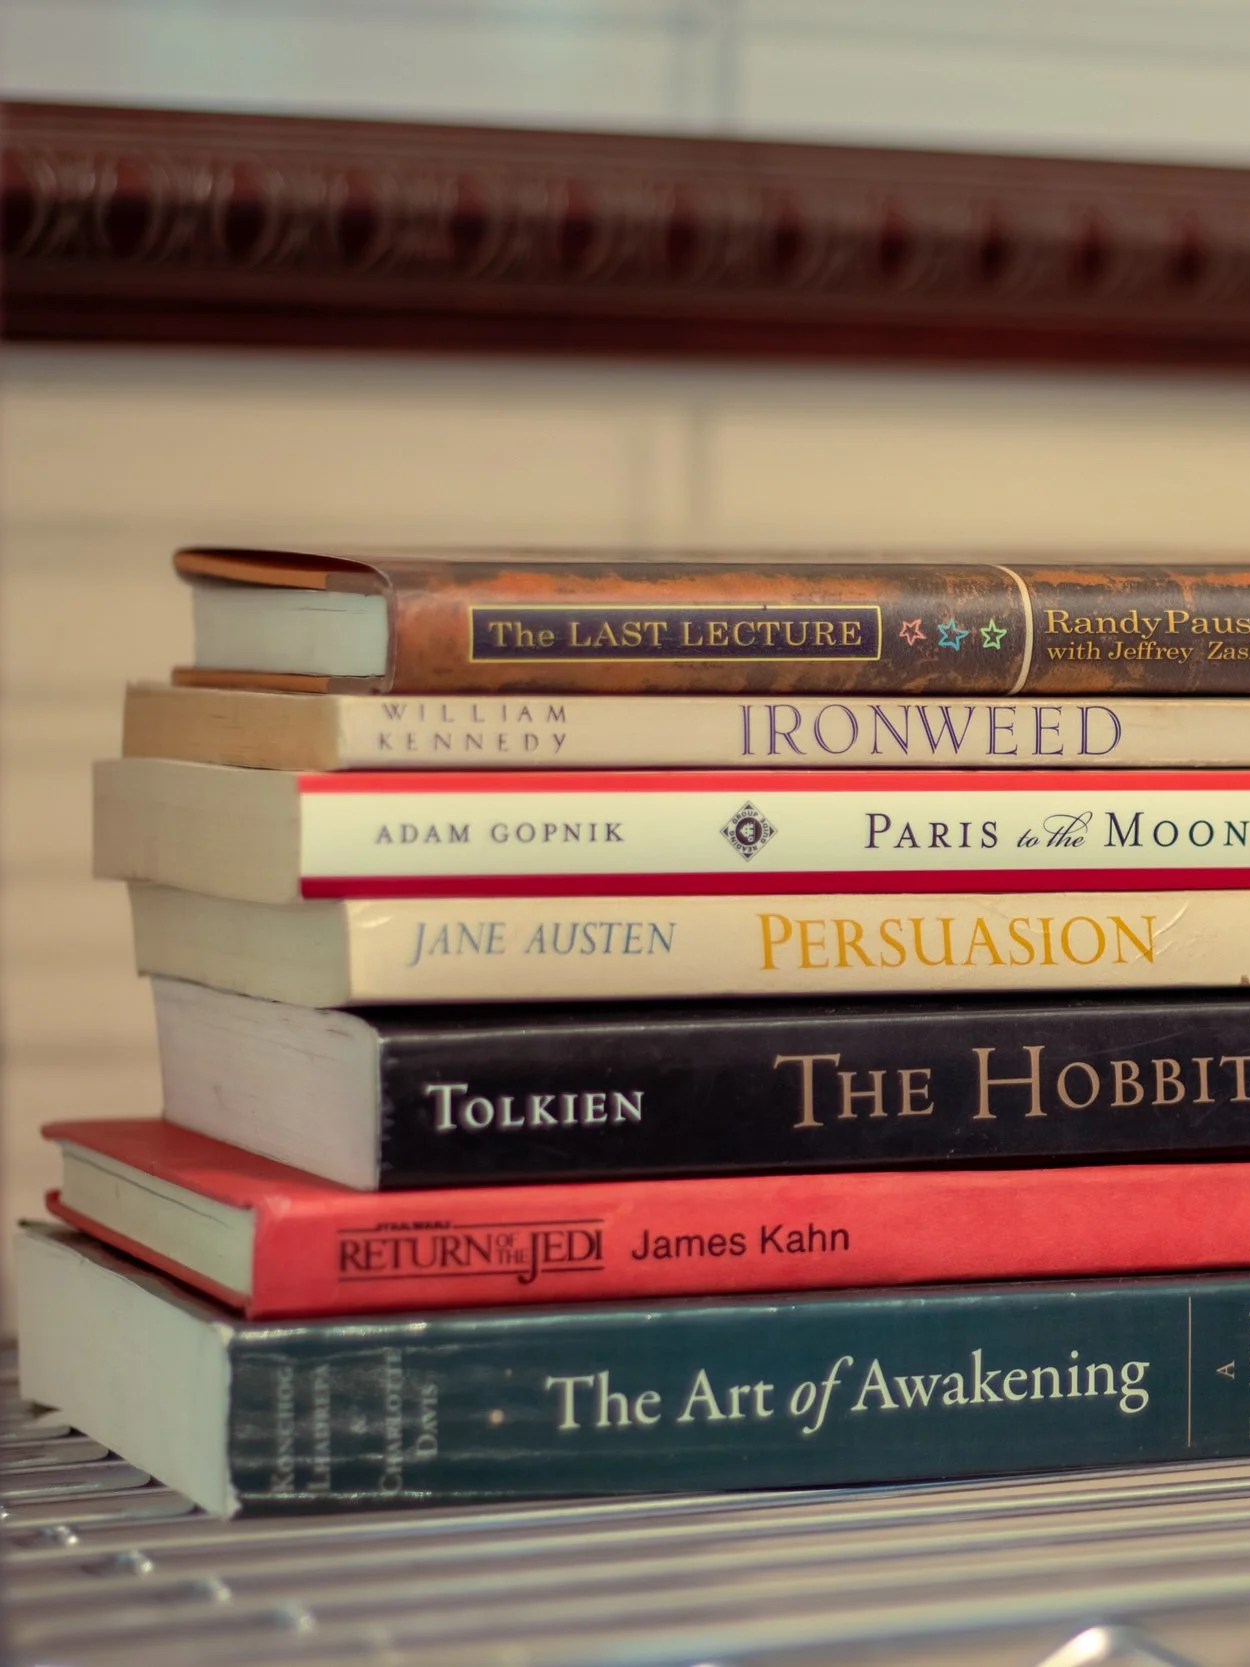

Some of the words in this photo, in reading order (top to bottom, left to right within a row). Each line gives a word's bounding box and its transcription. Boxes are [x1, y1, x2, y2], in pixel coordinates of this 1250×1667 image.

[488, 621, 556, 646] The
[567, 620, 668, 647] LAST
[680, 620, 863, 647] LECTURE
[1044, 608, 1166, 642] Randy
[1047, 641, 1102, 661] with
[1107, 641, 1195, 667] Jeffrey
[381, 703, 567, 723] WILLIAM
[739, 703, 1123, 756] IRONWEED
[378, 733, 567, 753] KENNEDY
[374, 823, 471, 845] ADAM
[489, 822, 626, 844] GOPNIK
[732, 810, 759, 825] GROUP
[864, 812, 999, 850] PARIS
[1016, 829, 1042, 849] to
[1042, 810, 1093, 849] the
[1104, 811, 1250, 848] MOON
[407, 921, 506, 968] JANE
[524, 920, 678, 955] AUSTEN
[756, 912, 1158, 970] PERSUASION
[425, 1082, 645, 1131] TOLKIEN
[773, 1052, 935, 1129] THE
[339, 1233, 495, 1273] RETURN
[494, 1231, 517, 1247] OF
[497, 1247, 529, 1265] THE
[517, 1229, 605, 1285] JEDI
[631, 1229, 748, 1260] James
[760, 1222, 850, 1255] Kahn
[1216, 1360, 1235, 1380] A
[545, 1370, 661, 1430] The
[677, 1369, 775, 1423] Art
[790, 1355, 855, 1434] of
[850, 1348, 1150, 1415] Awakening
[270, 1366, 295, 1493] KONCHOG
[379, 1347, 403, 1493] CHARLOTTE
[416, 1382, 438, 1458] DAVIS
